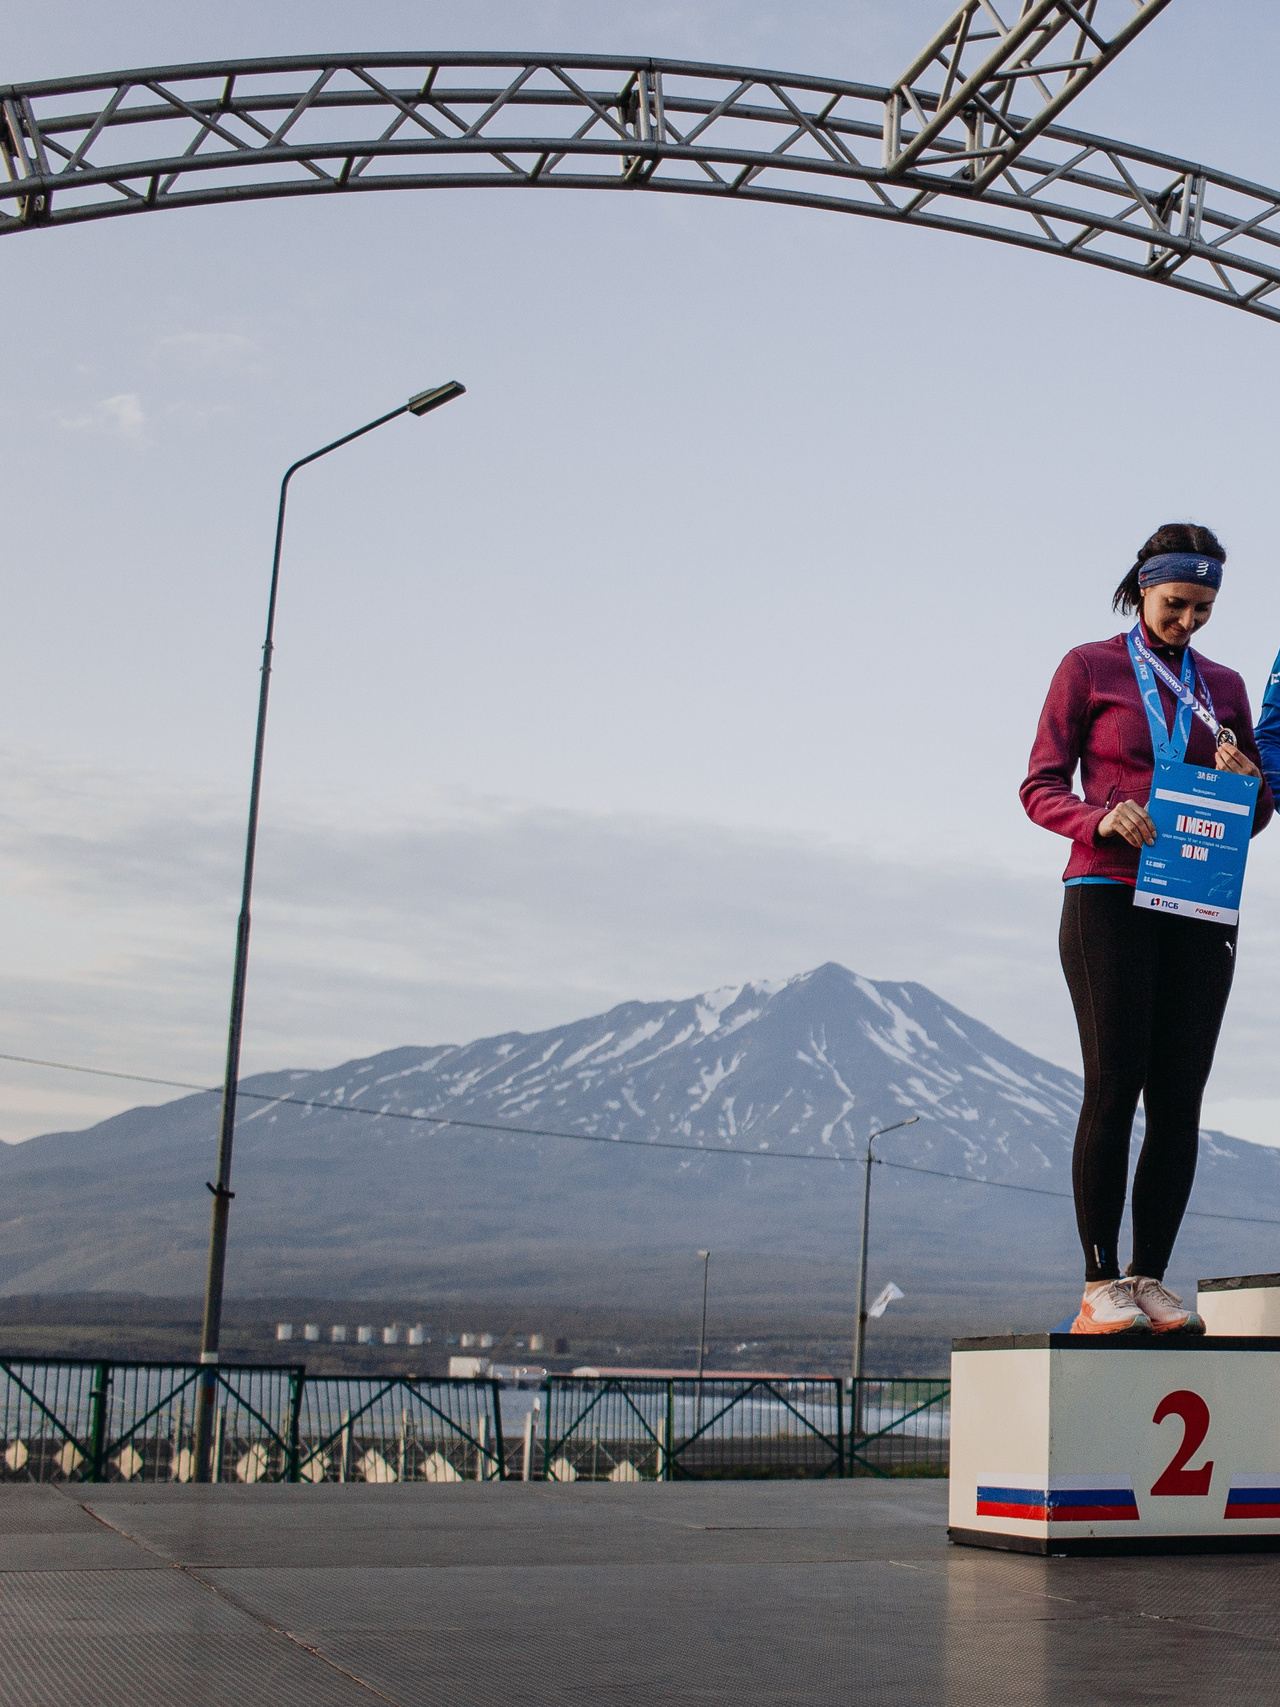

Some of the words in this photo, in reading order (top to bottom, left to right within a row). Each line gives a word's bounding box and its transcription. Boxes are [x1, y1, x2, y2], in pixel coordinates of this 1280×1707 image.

[1185, 816, 1226, 840] МЕСТО
[1181, 843, 1192, 858] 10
[1193, 846, 1209, 861] КМ
[1162, 900, 1179, 909] ПСБ
[1195, 907, 1219, 916] FONBET
[1150, 1390, 1214, 1496] 2
